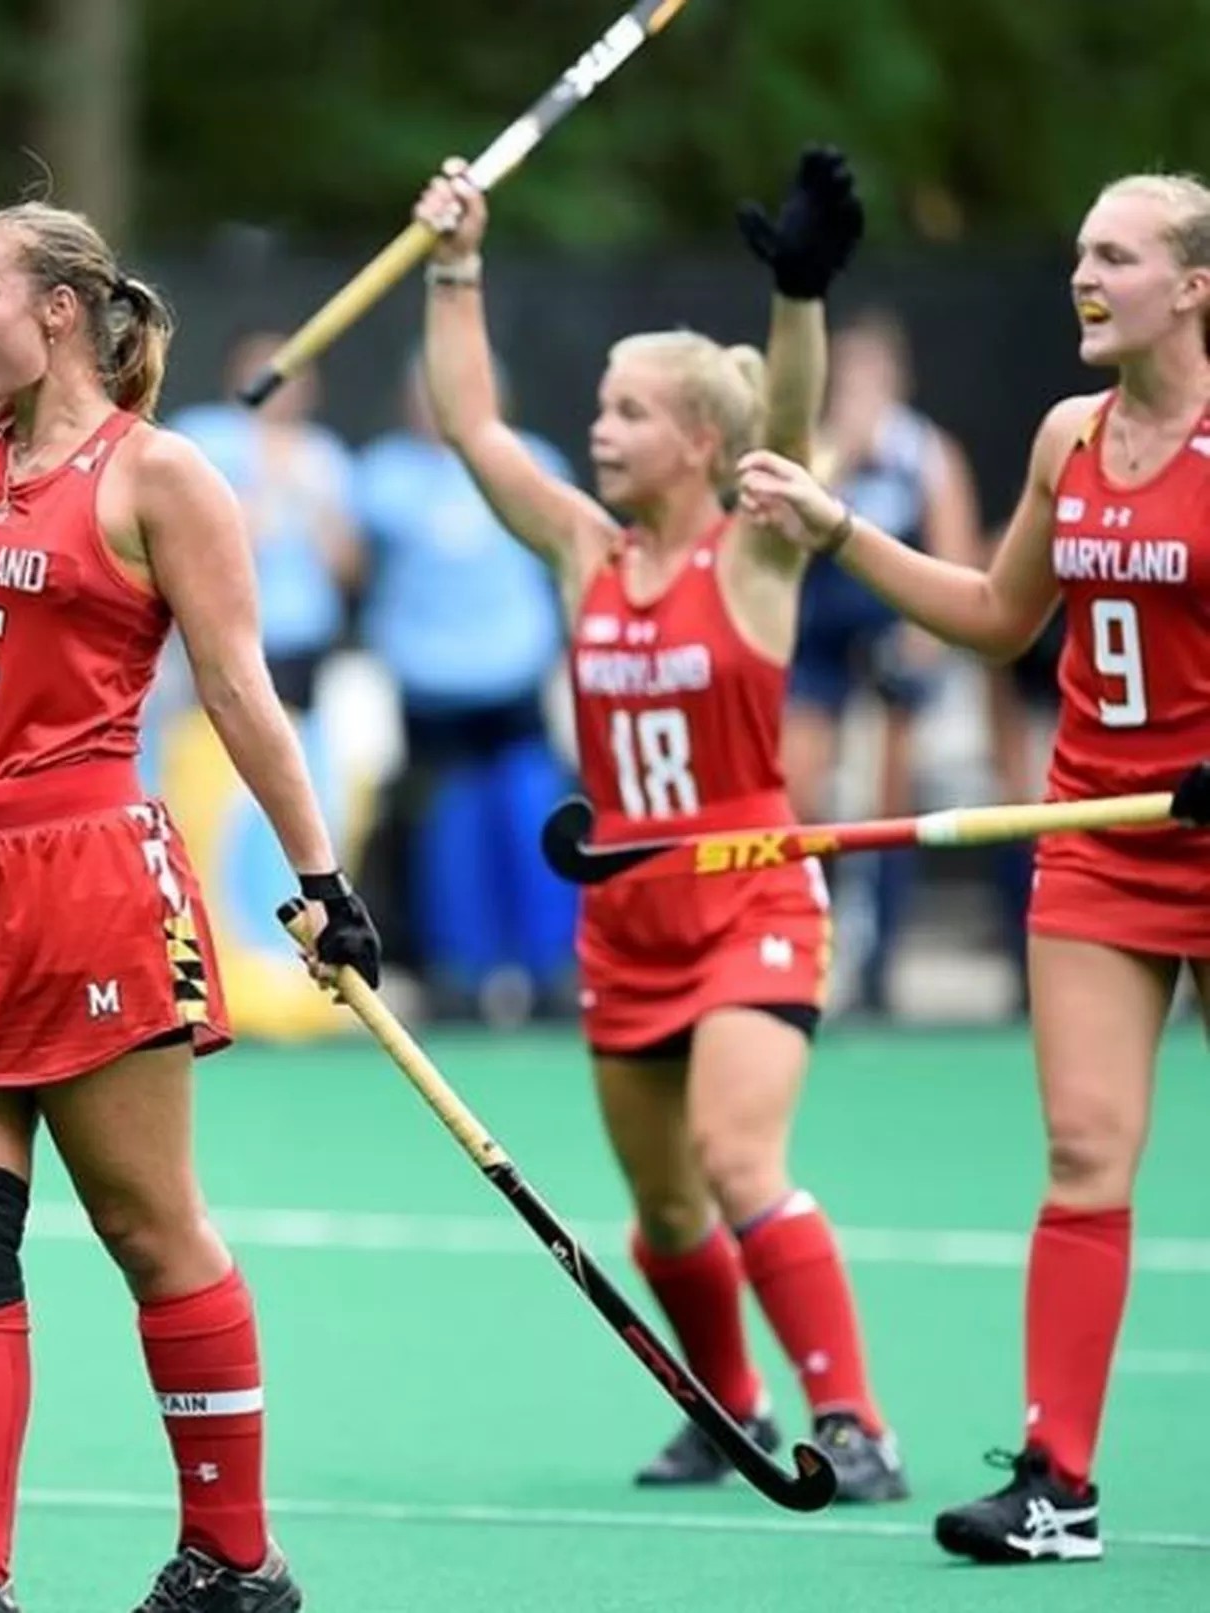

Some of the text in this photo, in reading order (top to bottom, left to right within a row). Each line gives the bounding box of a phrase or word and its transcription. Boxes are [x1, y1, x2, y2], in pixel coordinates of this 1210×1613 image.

[1092, 599, 1147, 727] 9
[610, 708, 701, 822] 18
[694, 832, 789, 874] STX
[86, 978, 121, 1017] M
